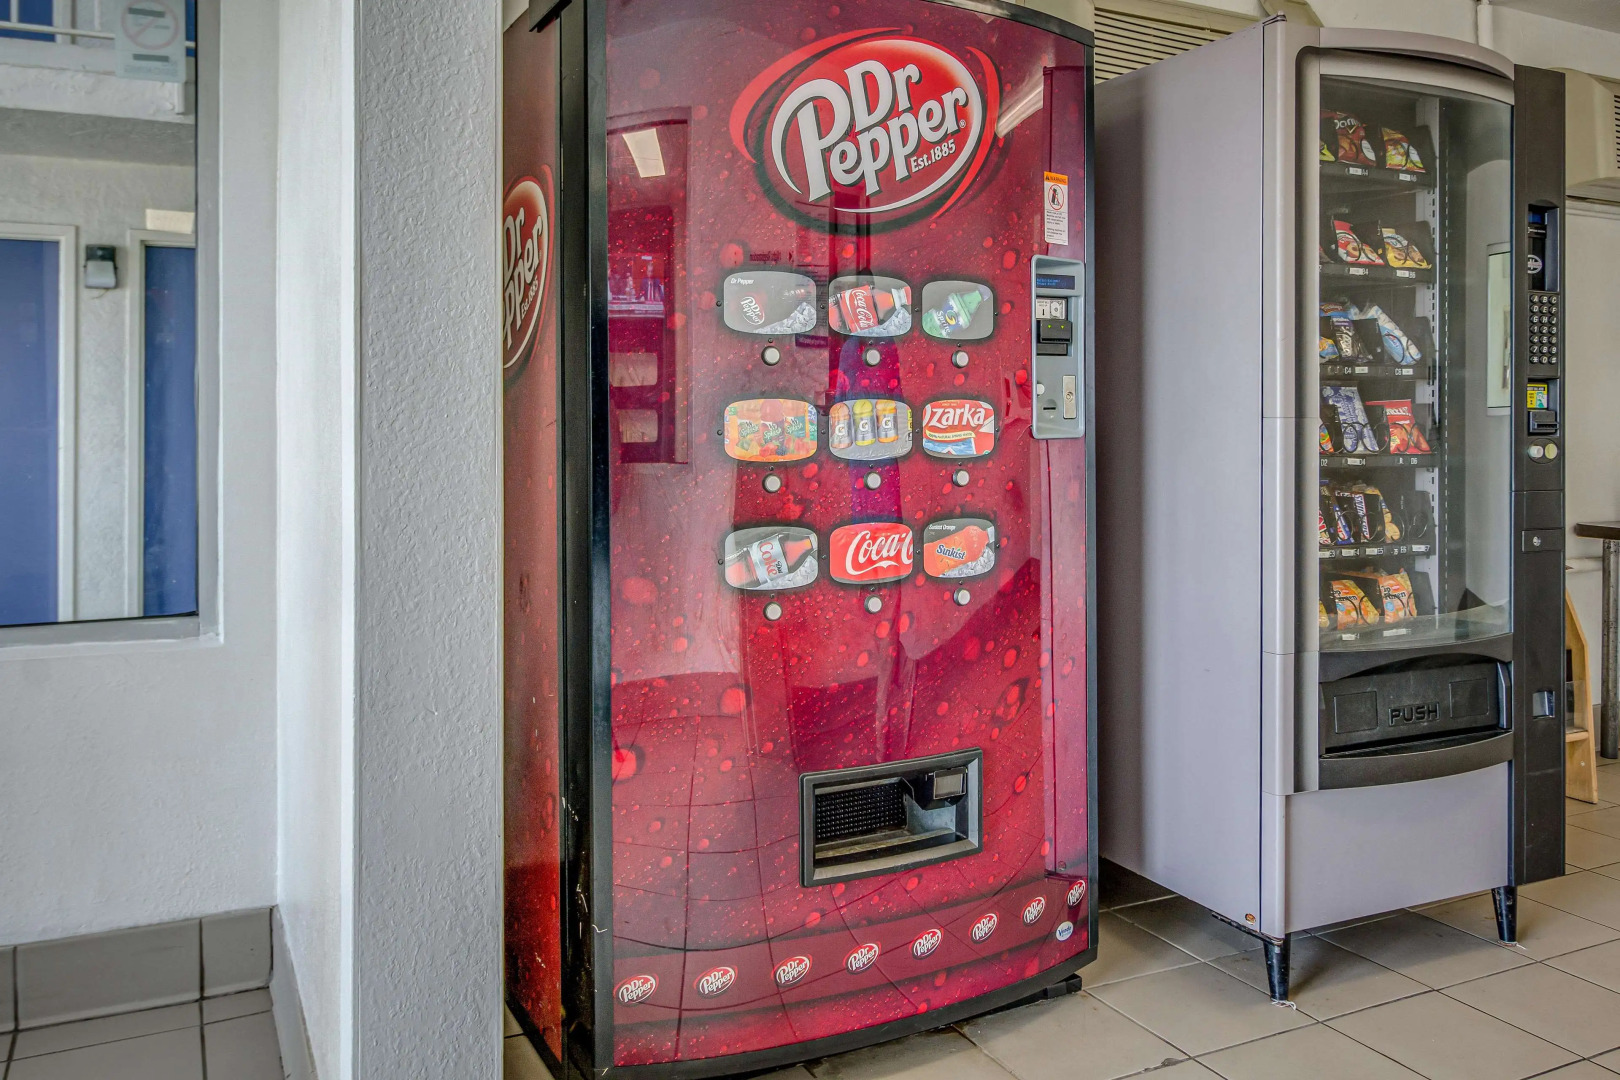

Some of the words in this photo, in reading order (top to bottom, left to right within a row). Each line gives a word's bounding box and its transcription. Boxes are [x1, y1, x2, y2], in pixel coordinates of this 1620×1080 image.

[844, 60, 921, 134] Dr
[772, 79, 969, 202] Pepper
[737, 278, 755, 286] Pepper
[758, 542, 778, 577] Coke
[936, 543, 967, 561] Sunkist
[1389, 702, 1440, 727] PUSH
[1023, 903, 1045, 924] Pepper
[1029, 901, 1039, 912] Dr
[972, 919, 996, 941] Pepper
[980, 917, 990, 929] Dr
[913, 934, 939, 957] Pepper
[922, 932, 933, 943] Dr
[847, 949, 876, 972] Pepper
[857, 947, 869, 958] Dr
[776, 962, 808, 984] Pepper
[786, 960, 799, 970] Dr
[632, 979, 644, 990] Dr
[700, 973, 734, 995] Pepper
[711, 971, 724, 981] Dr
[619, 980, 653, 1003] Pepper
